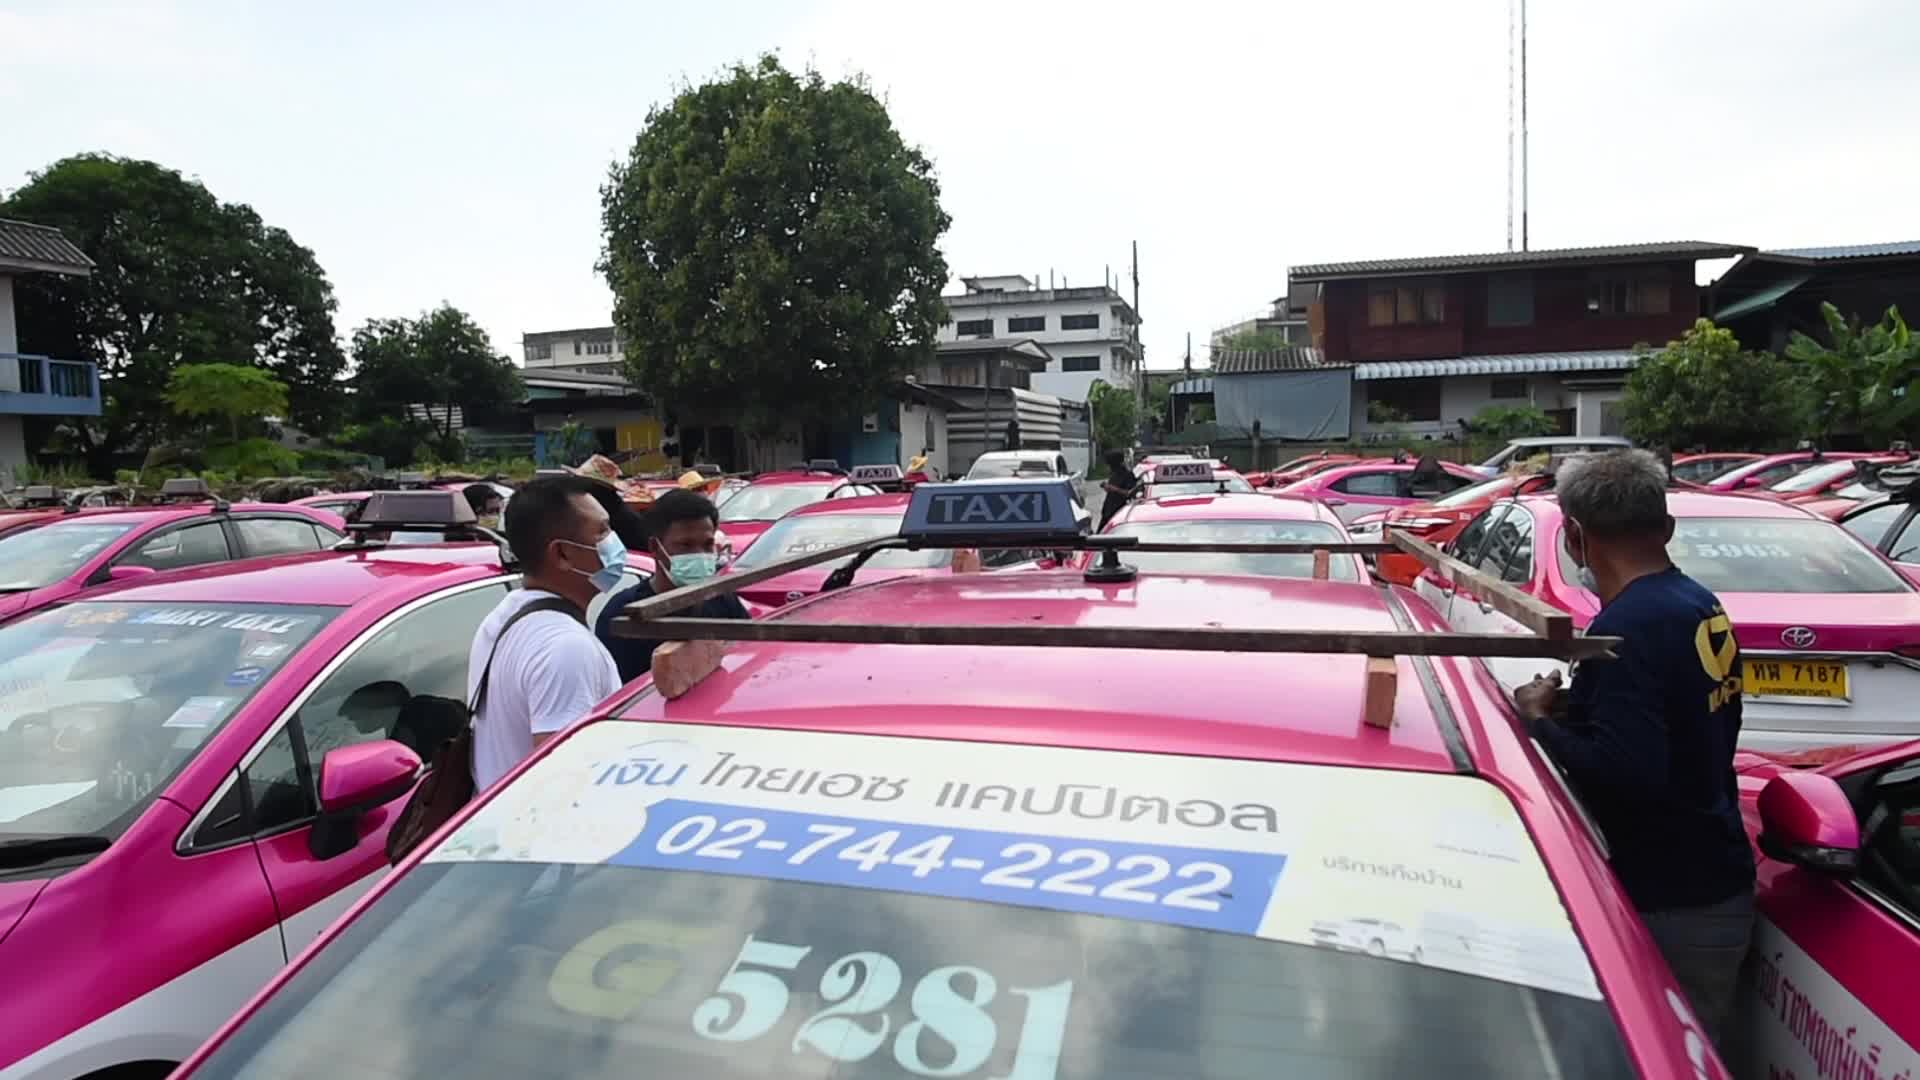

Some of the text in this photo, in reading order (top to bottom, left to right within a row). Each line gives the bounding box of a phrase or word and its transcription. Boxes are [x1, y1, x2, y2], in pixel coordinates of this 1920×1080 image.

[1164, 465, 1206, 477] TAXI
[933, 494, 1045, 522] TAXI
[1790, 663, 1842, 683] 7187
[934, 781, 1279, 834] แคปปิตอล
[655, 814, 1234, 913] 02-744-2222
[692, 933, 1074, 1080] 5281
